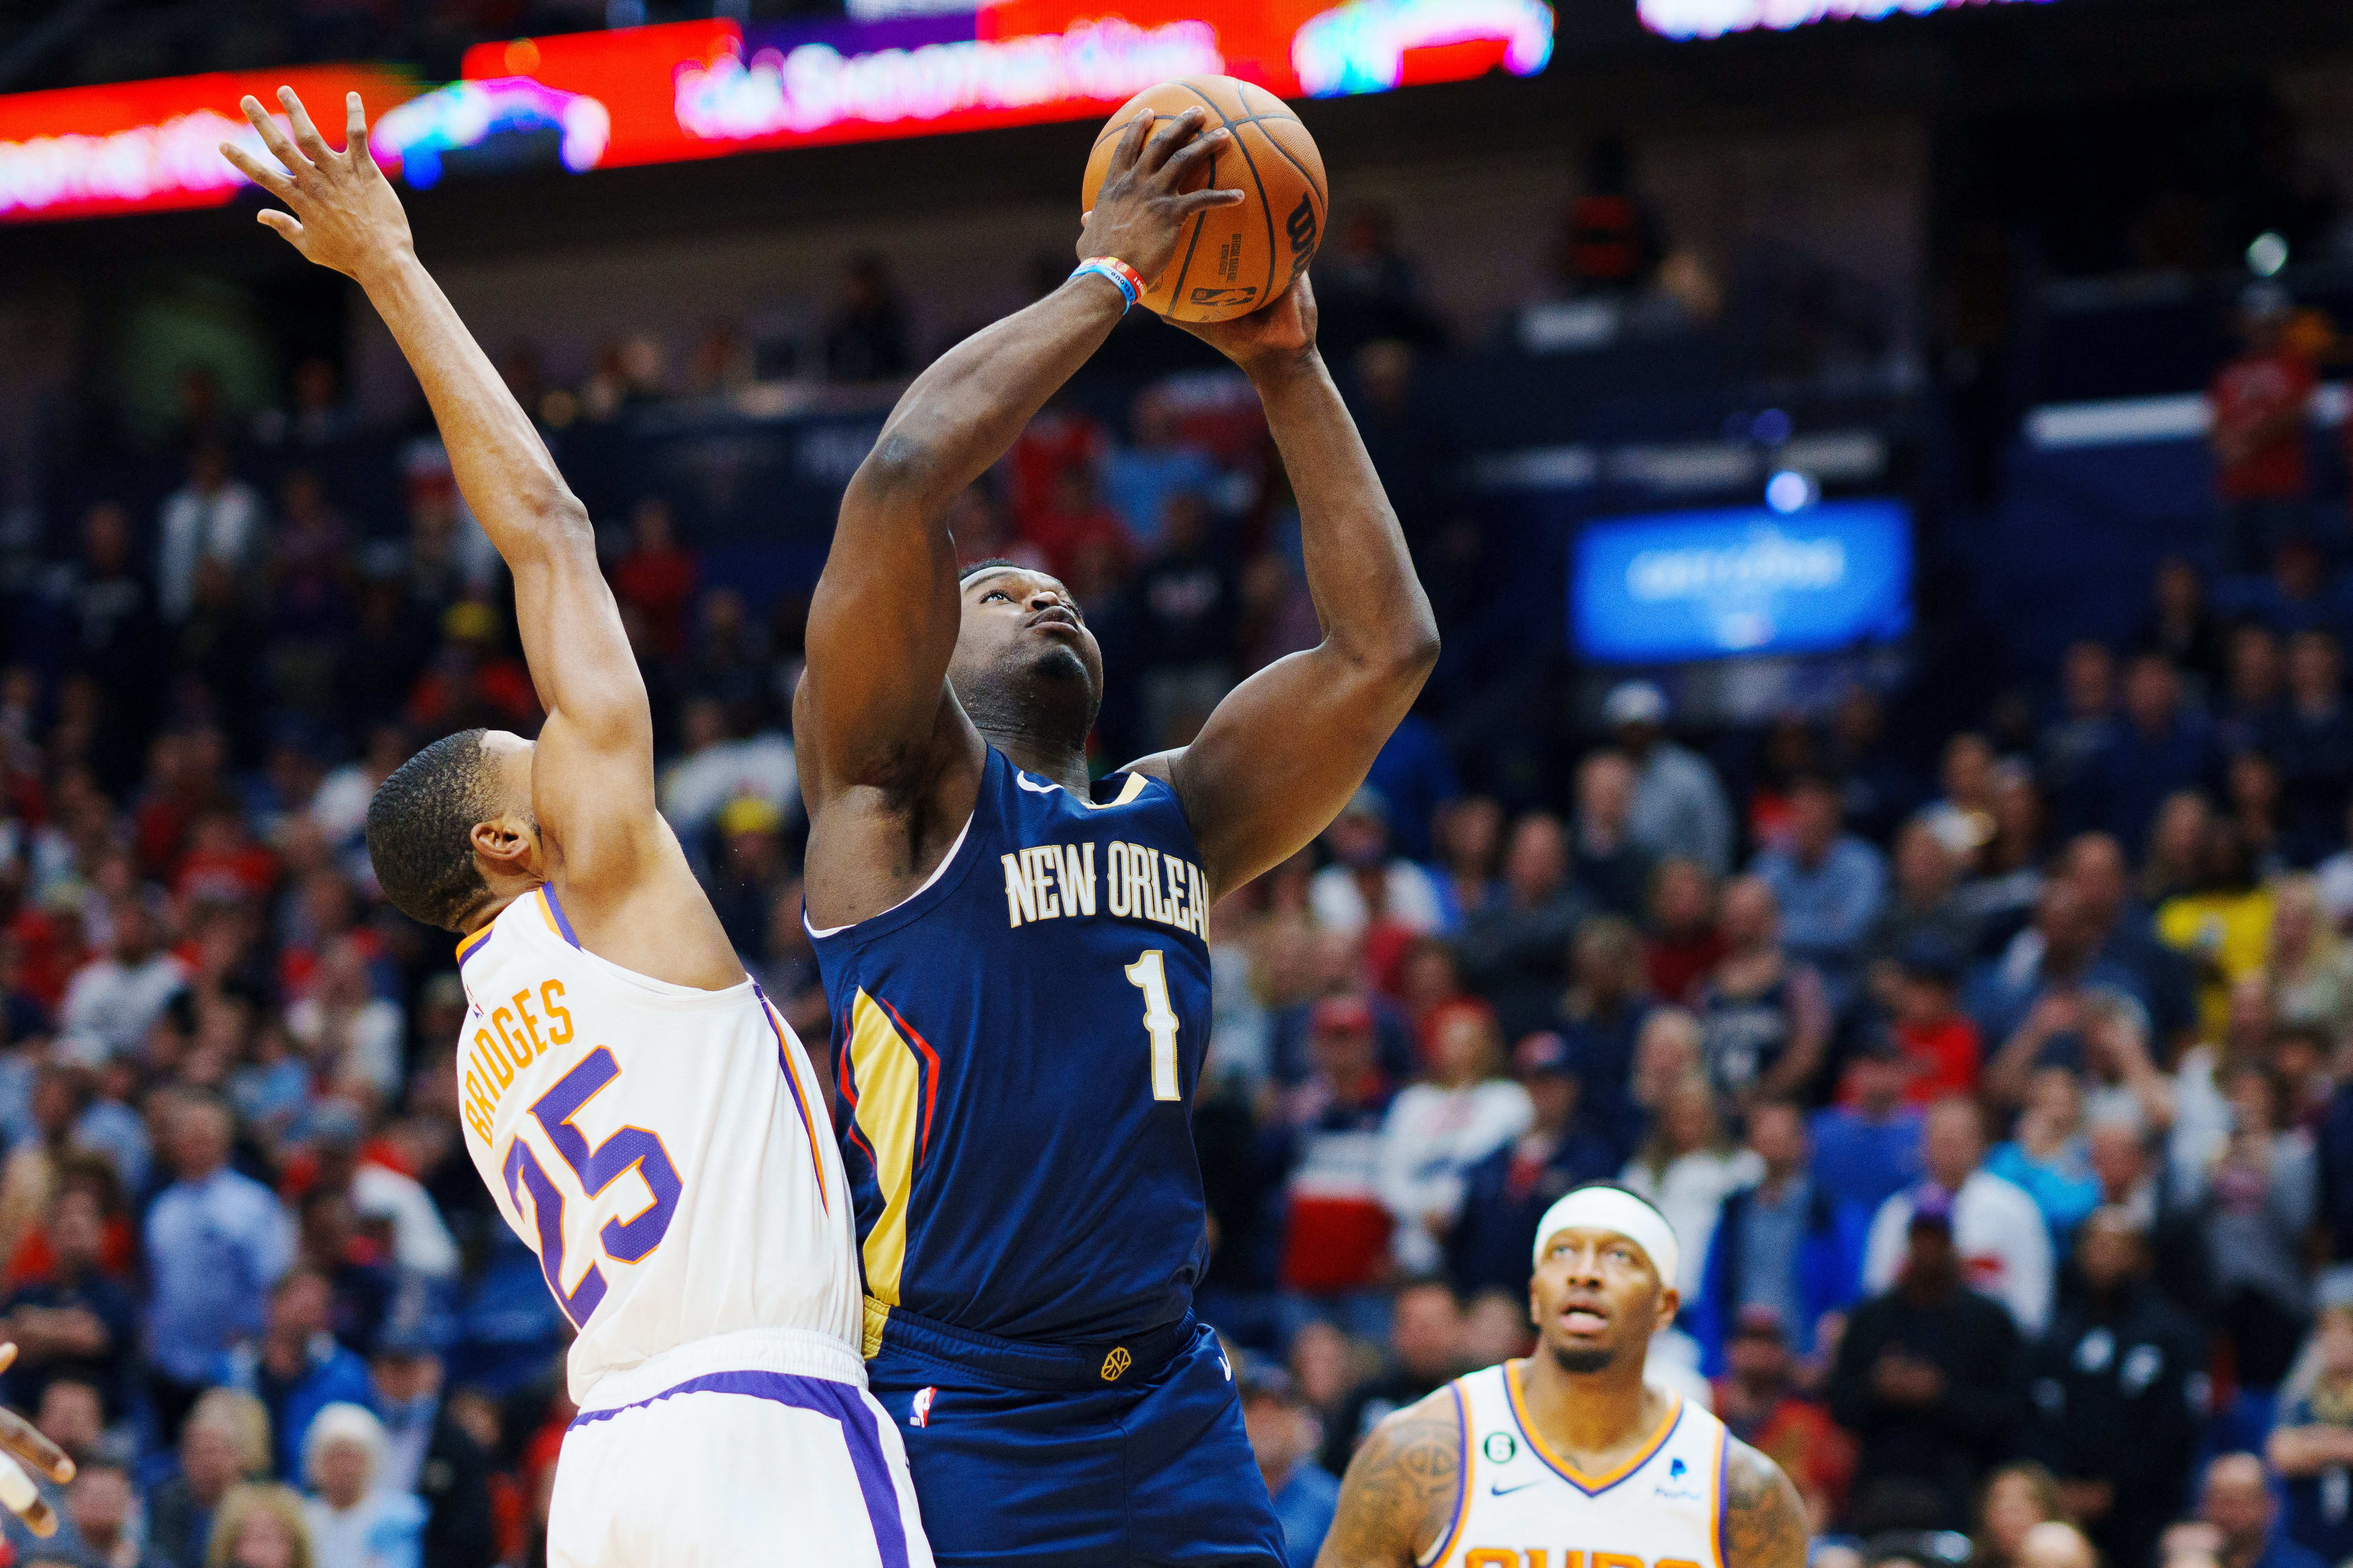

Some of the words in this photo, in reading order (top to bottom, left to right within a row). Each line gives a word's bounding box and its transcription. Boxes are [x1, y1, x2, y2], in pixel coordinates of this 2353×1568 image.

[1001, 842, 1097, 929] NEW
[465, 979, 574, 1149] BRIDGES
[1124, 949, 1181, 1102] 1
[502, 1045, 684, 1329] 25
